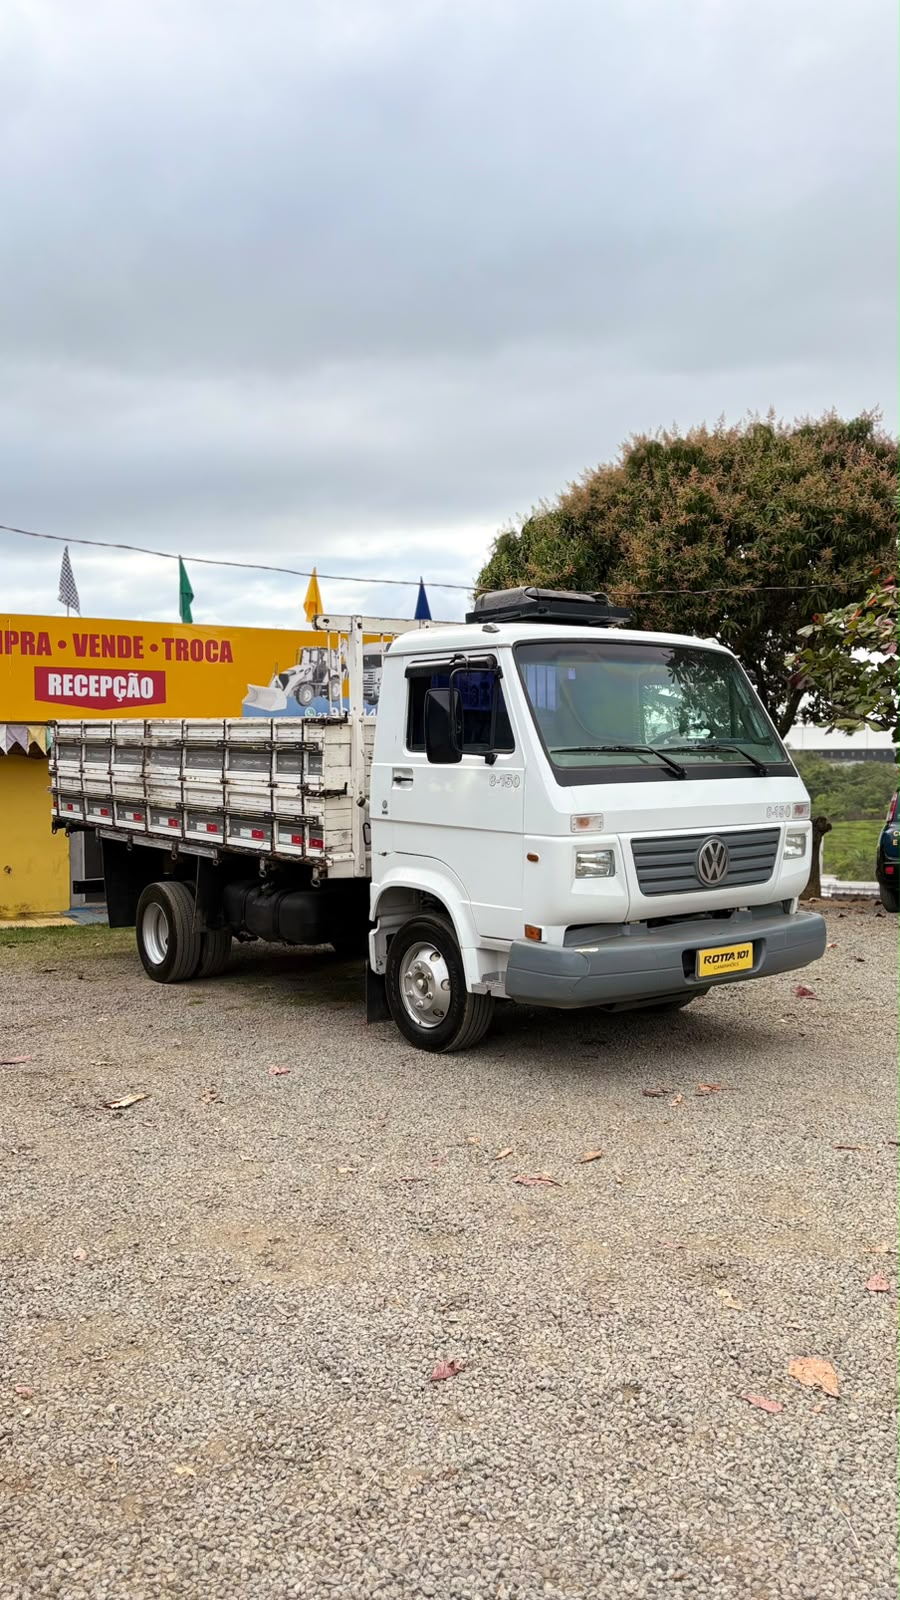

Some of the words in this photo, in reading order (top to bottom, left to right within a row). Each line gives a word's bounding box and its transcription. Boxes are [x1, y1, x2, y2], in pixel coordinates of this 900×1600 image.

[0, 630, 52, 656] PRA
[72, 633, 144, 659] VENDE
[162, 638, 233, 663] TROCA
[48, 672, 154, 702] RECEPÇÃO
[489, 773, 520, 788] 8-150
[699, 839, 728, 884] VW
[703, 951, 736, 965] ROTTA
[737, 949, 750, 960] 101
